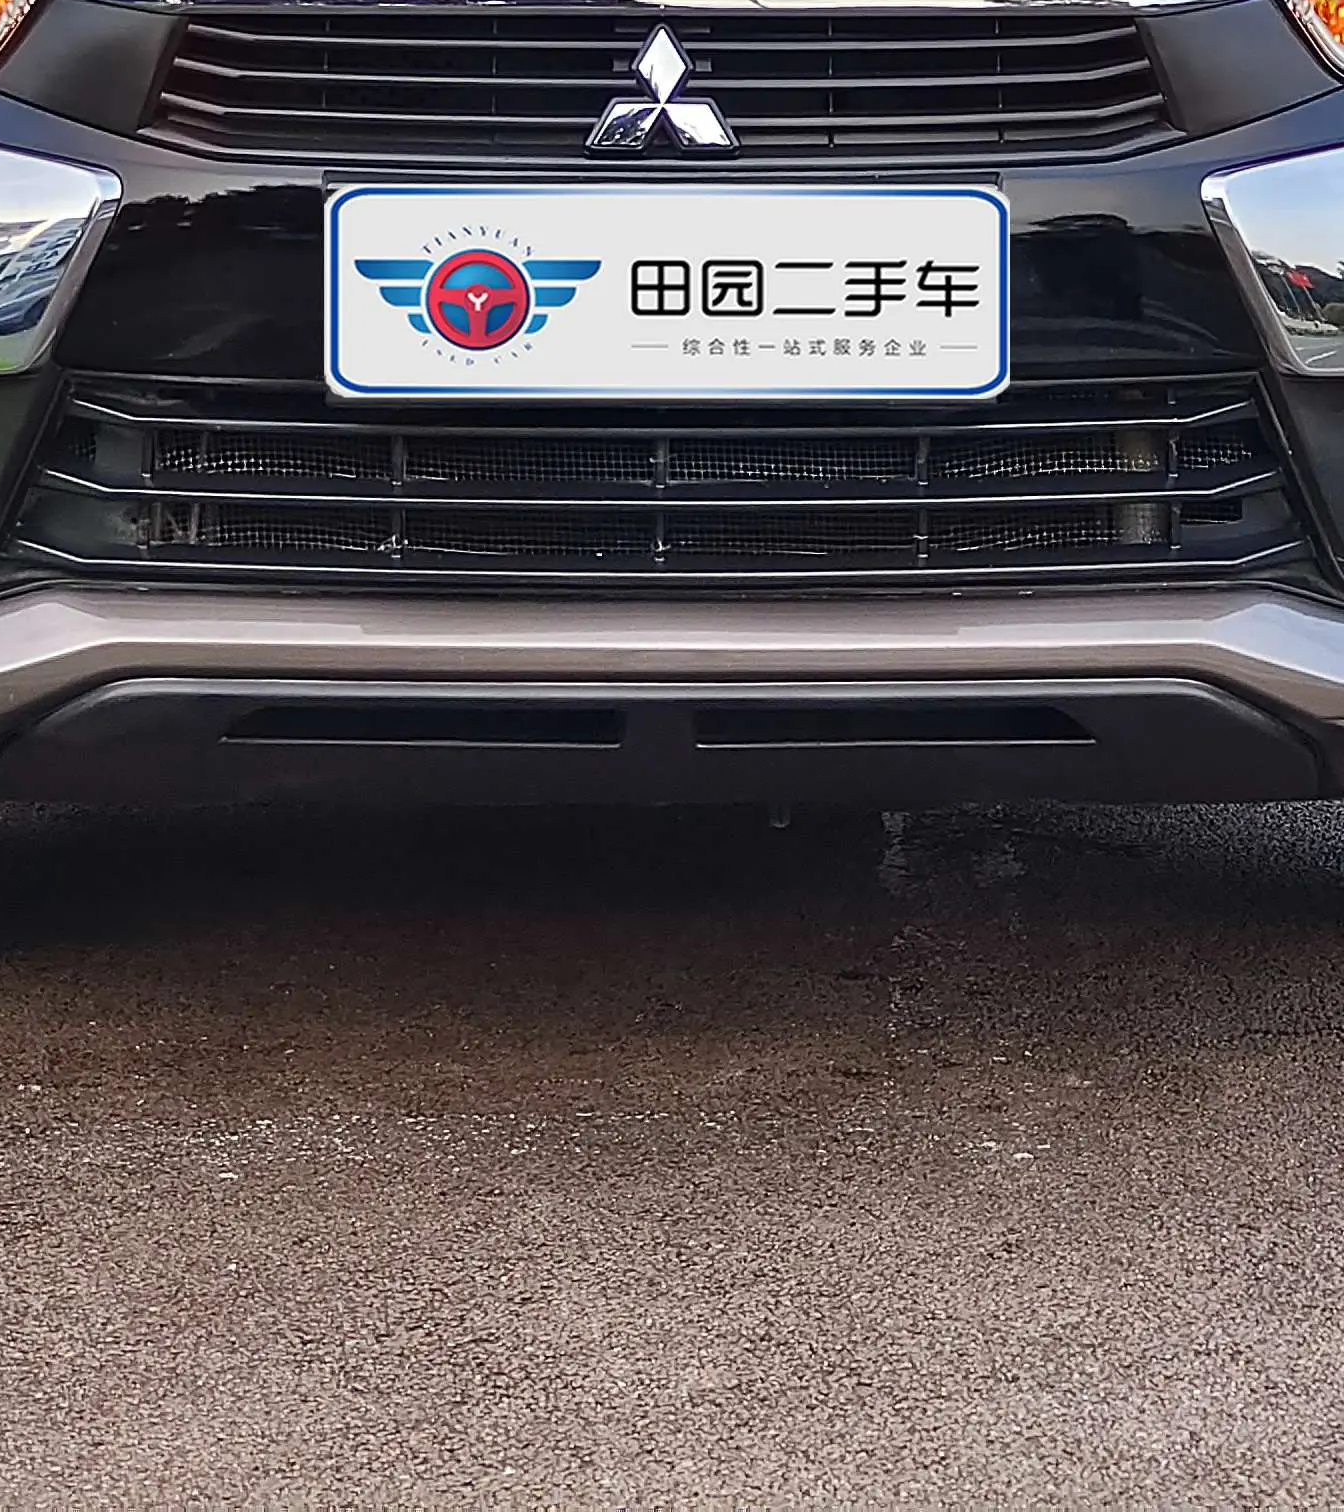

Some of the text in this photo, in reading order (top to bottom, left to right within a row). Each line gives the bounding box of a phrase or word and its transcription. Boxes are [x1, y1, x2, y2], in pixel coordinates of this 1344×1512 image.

[631, 259, 981, 318] 田园二手车
[682, 338, 927, 357] 综合性一站式服务企业
